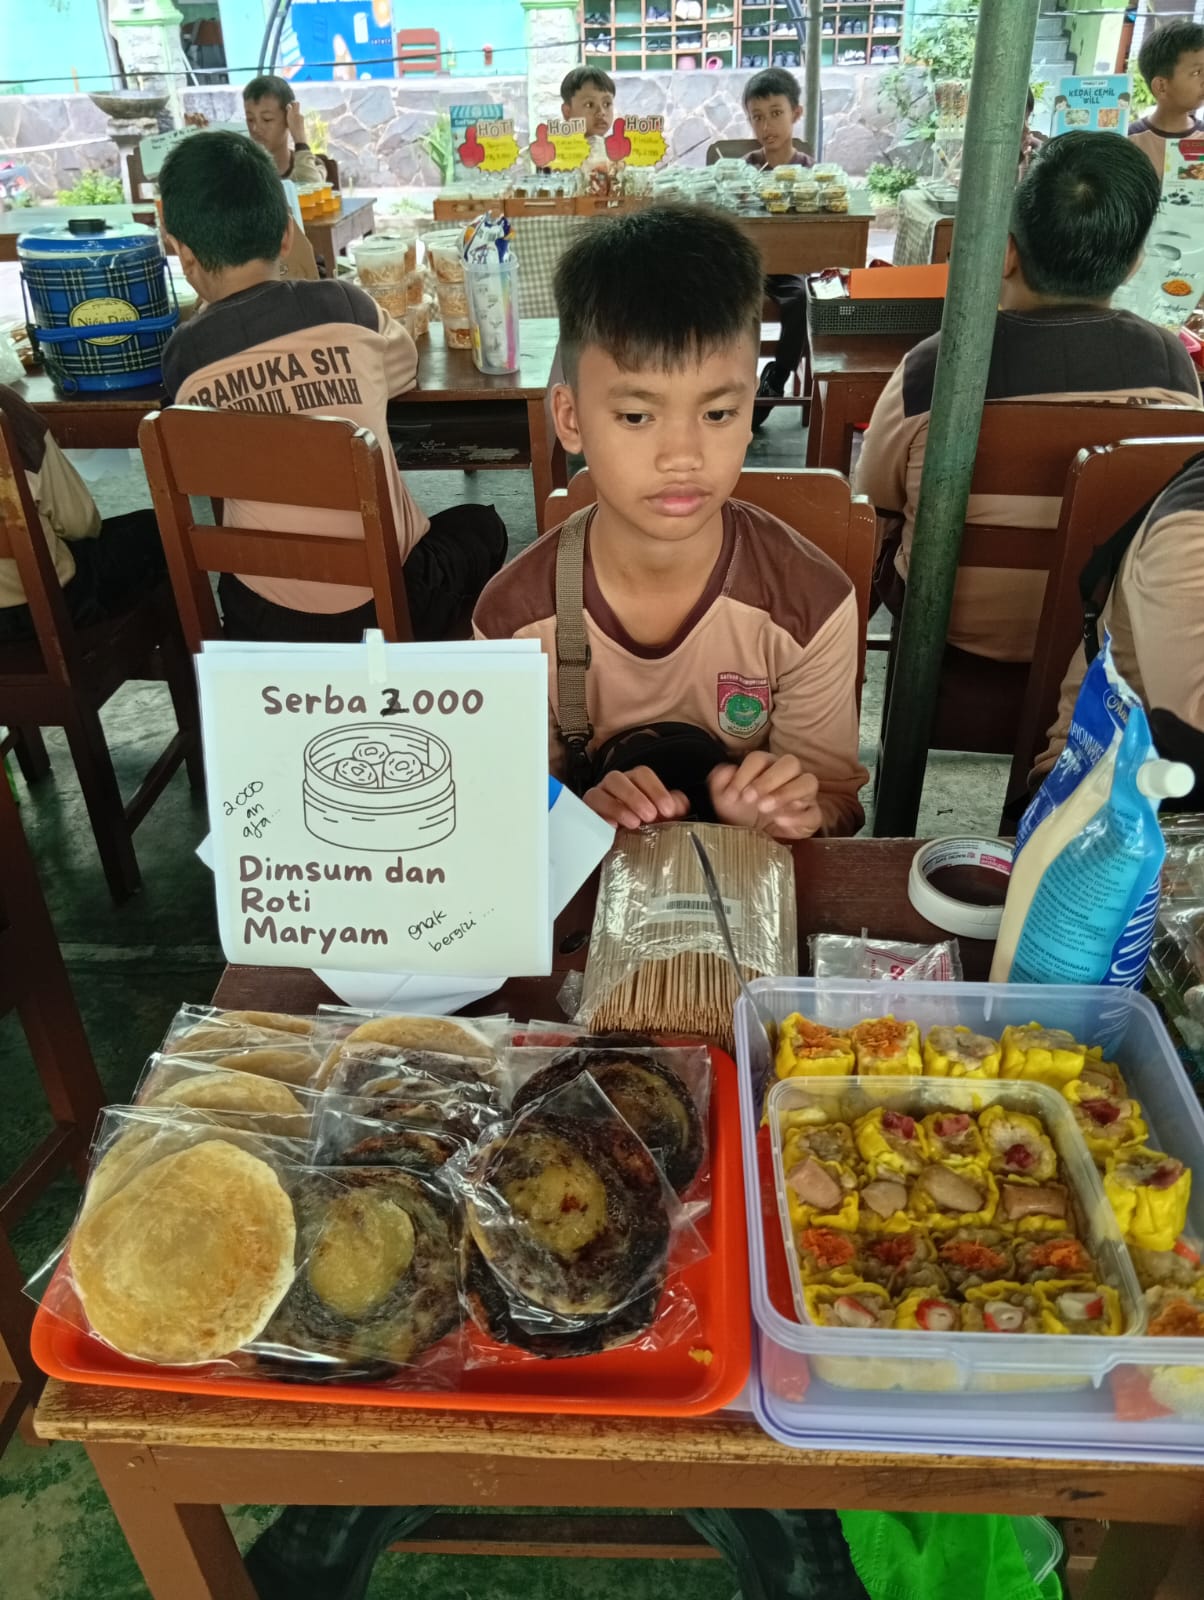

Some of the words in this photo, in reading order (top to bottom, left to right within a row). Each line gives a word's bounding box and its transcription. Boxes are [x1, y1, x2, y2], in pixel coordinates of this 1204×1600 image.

[311, 346, 353, 376] SIT
[292, 378, 363, 411] HIKMAH
[261, 685, 368, 715] Serba
[223, 781, 264, 816] 2000
[246, 803, 264, 819] an
[239, 855, 372, 883] Dimsum
[385, 856, 446, 884] dan
[241, 887, 311, 914] Roti
[243, 916, 389, 954] Maryam
[408, 909, 447, 940] enak
